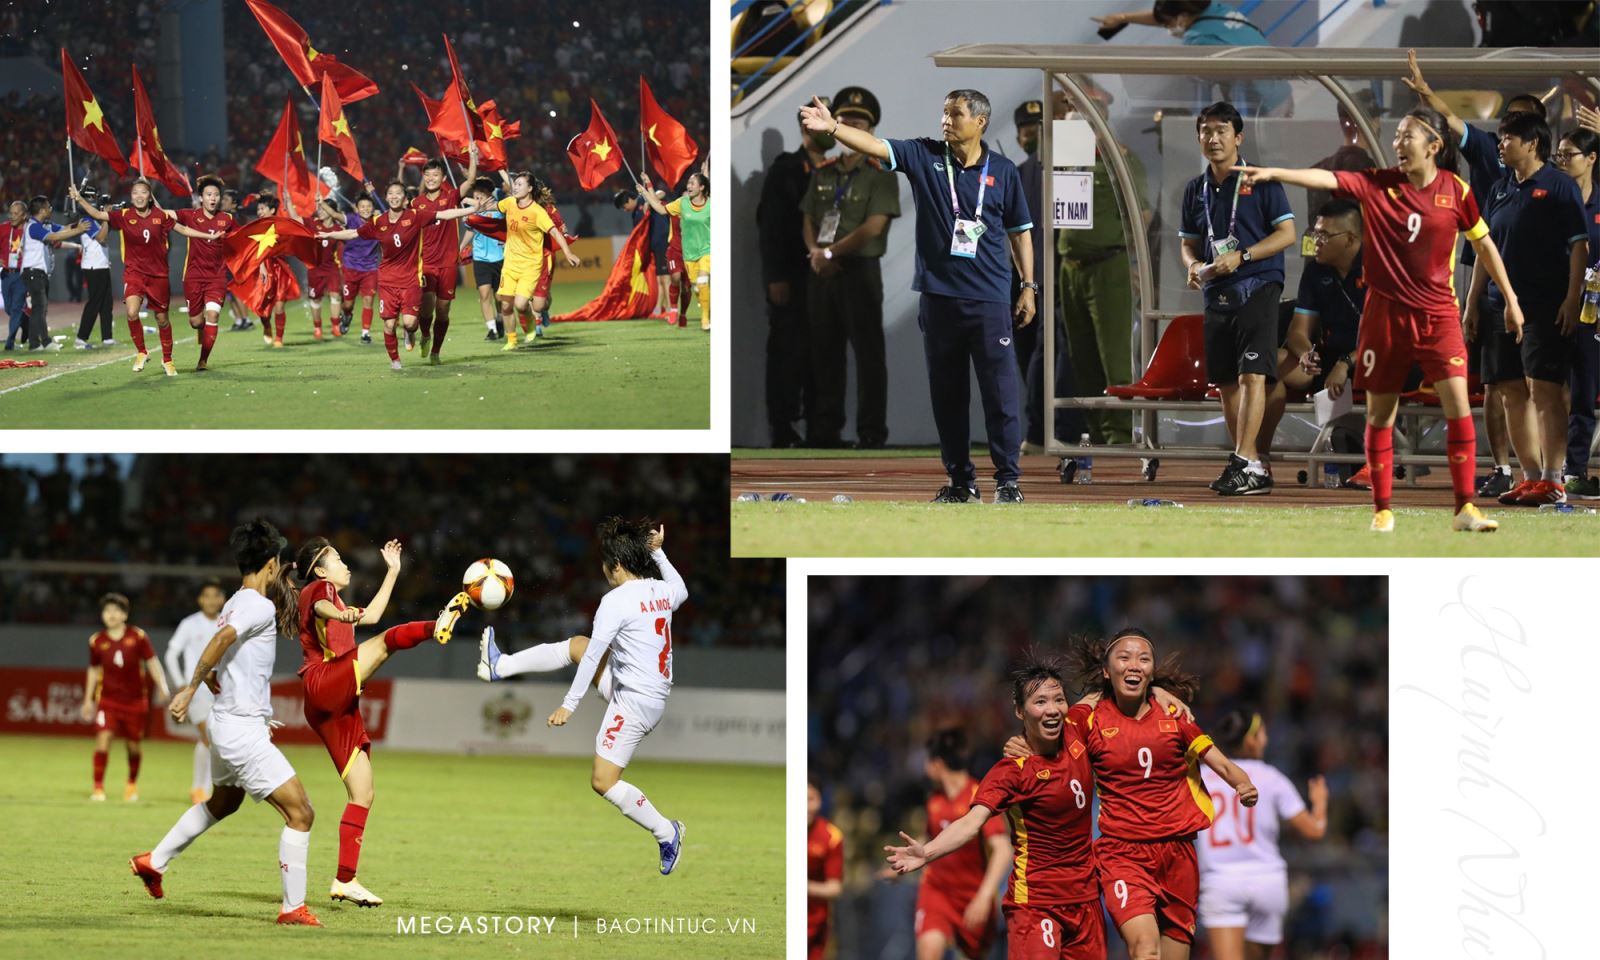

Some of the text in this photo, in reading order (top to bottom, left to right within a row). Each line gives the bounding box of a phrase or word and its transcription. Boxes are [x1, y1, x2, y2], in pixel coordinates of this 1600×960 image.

[1067, 202, 1088, 220] NAM
[143, 229, 150, 243] 9
[393, 233, 402, 248] 8
[1407, 213, 1422, 243] 9
[379, 299, 385, 313] 8
[1363, 349, 1376, 377] 9
[640, 598, 671, 613] A A MOE
[113, 650, 124, 668] 4
[654, 617, 670, 679] 2
[606, 714, 625, 741] 2
[1137, 747, 1153, 779] 9
[1069, 779, 1086, 809] 8
[1209, 790, 1256, 849] 20
[1114, 879, 1128, 909] 9
[1040, 918, 1055, 948] 8
